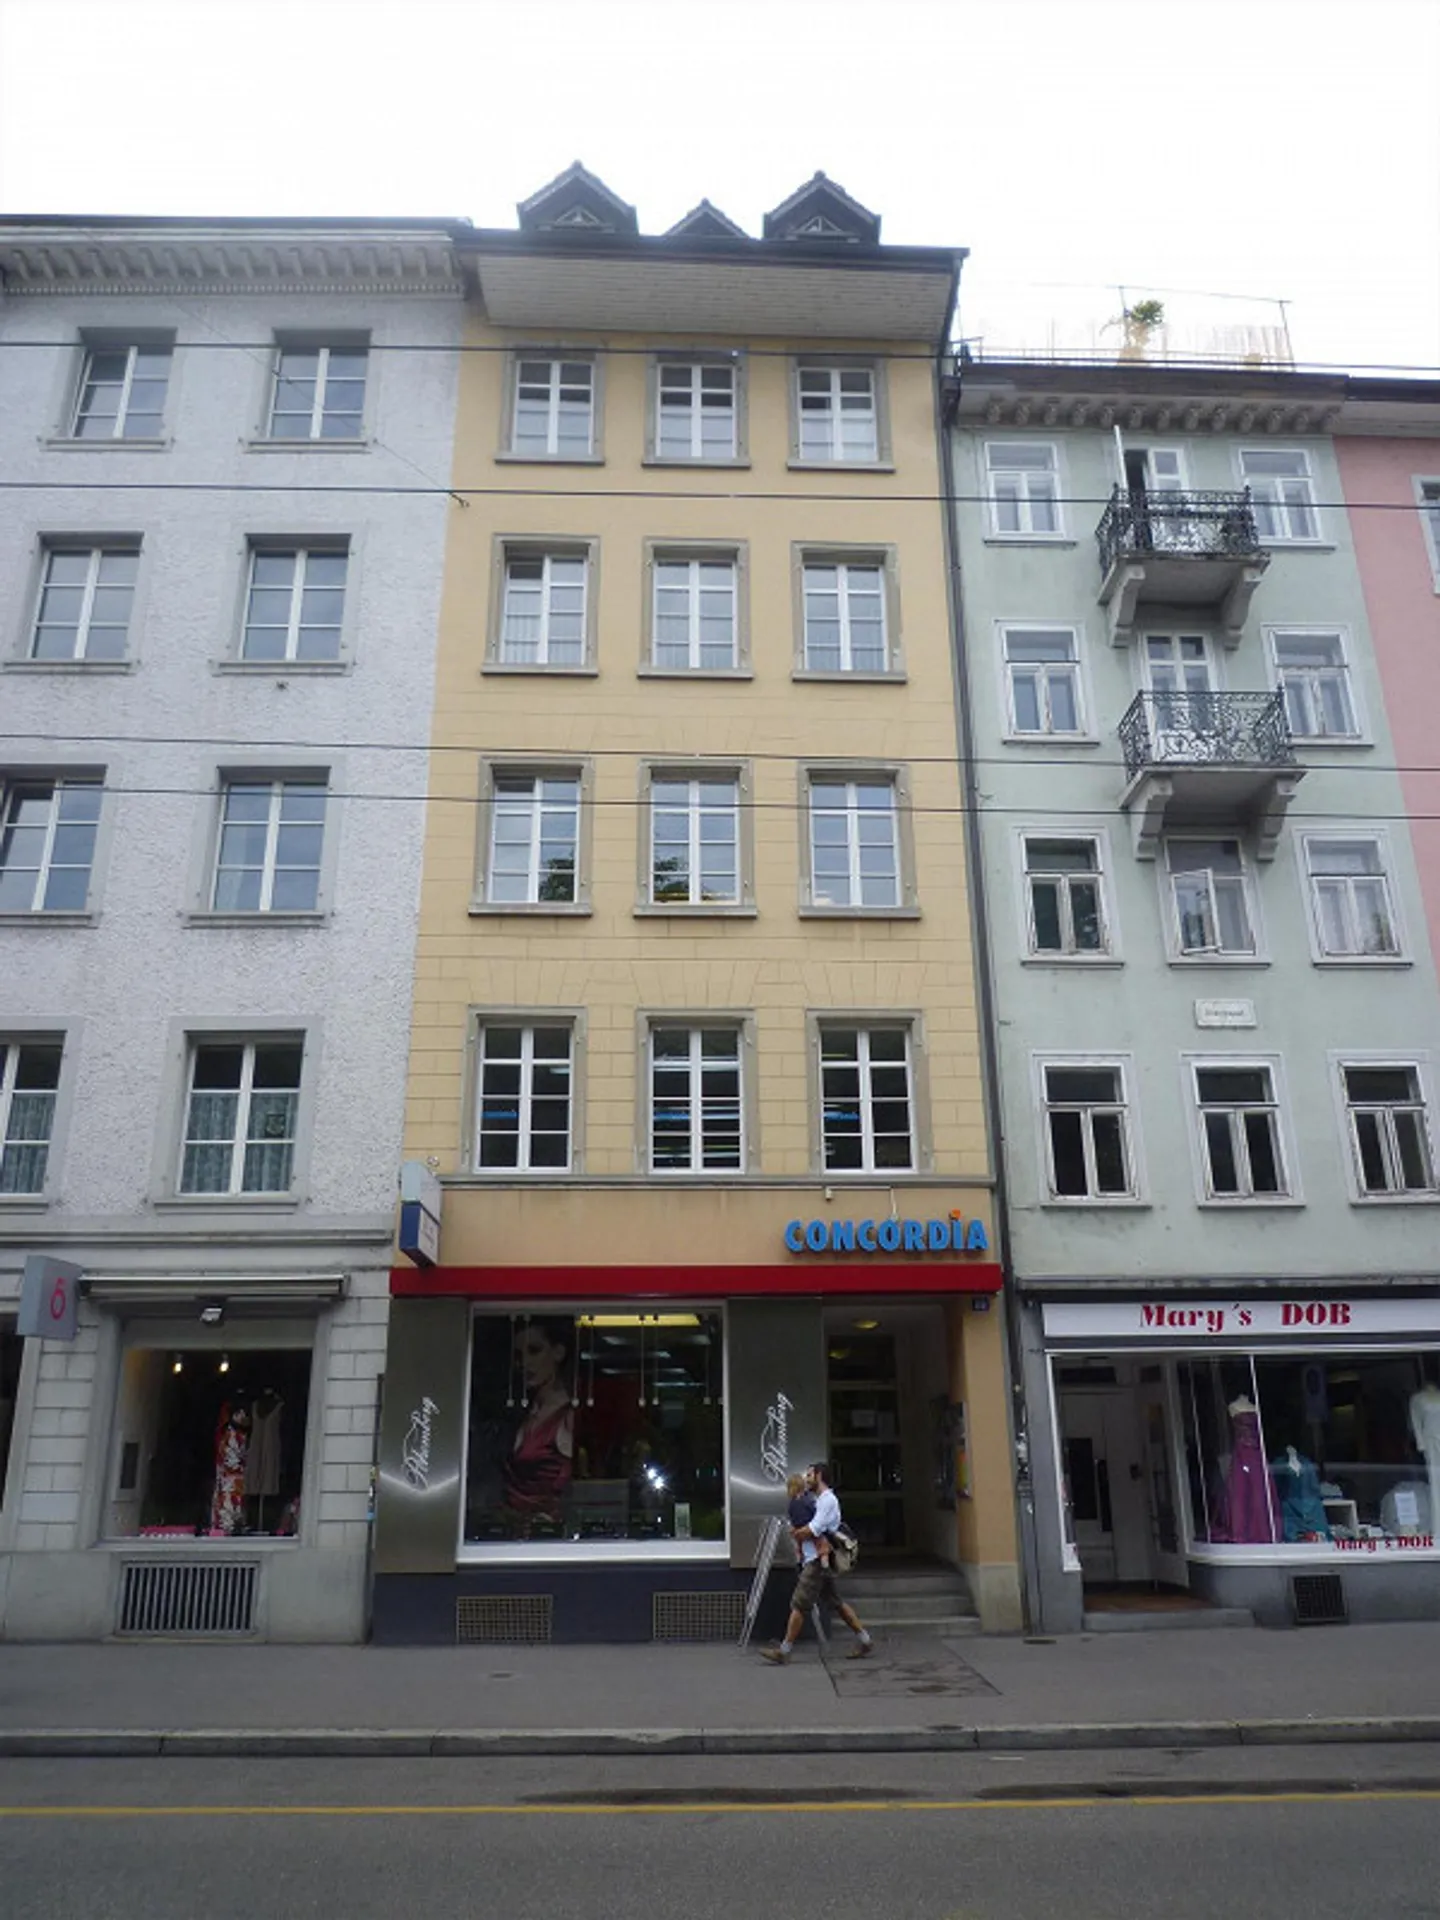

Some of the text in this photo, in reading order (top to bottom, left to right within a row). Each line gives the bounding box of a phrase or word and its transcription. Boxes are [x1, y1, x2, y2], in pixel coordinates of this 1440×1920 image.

[784, 1210, 989, 1252] CONCORDIA
[1281, 1302, 1351, 1326] DOB
[1334, 1535, 1391, 1553] Marys
